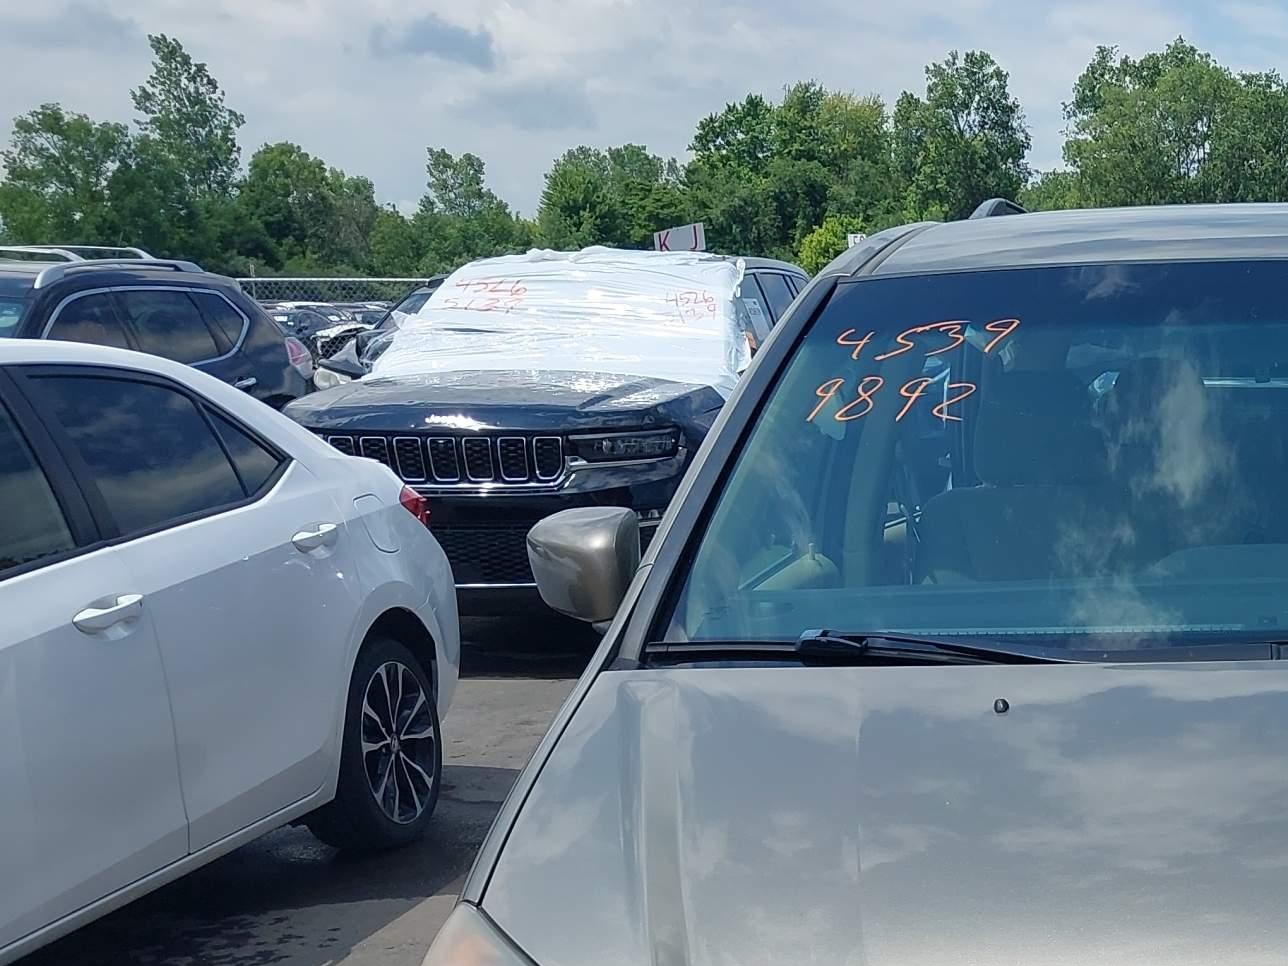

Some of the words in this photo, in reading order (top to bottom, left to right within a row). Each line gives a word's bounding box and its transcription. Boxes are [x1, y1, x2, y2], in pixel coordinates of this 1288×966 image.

[658, 231, 671, 251] K
[690, 225, 698, 249] J
[836, 319, 1020, 360] 4539
[806, 376, 976, 422] 9892
